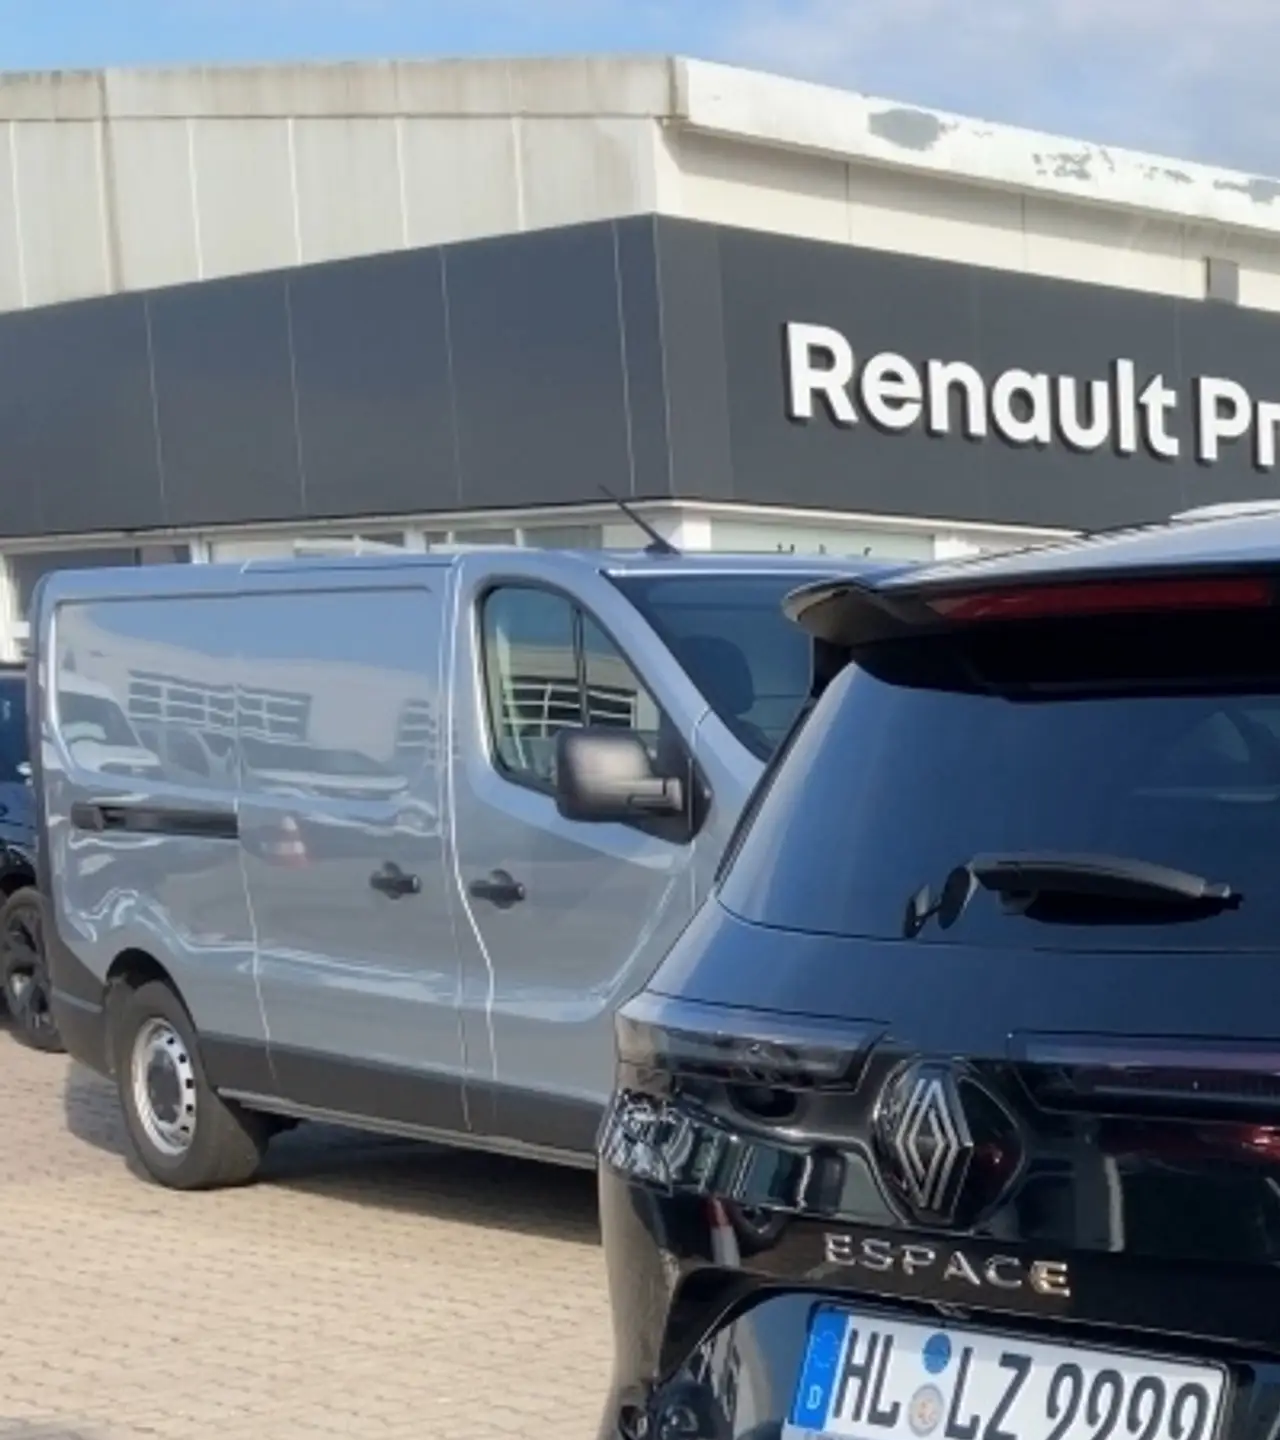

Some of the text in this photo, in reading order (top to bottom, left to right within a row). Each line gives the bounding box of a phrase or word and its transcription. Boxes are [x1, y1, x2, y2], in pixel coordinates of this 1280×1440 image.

[785, 321, 1180, 457] Renault
[823, 1231, 1071, 1297] ESPACE
[833, 1327, 901, 1428] HL
